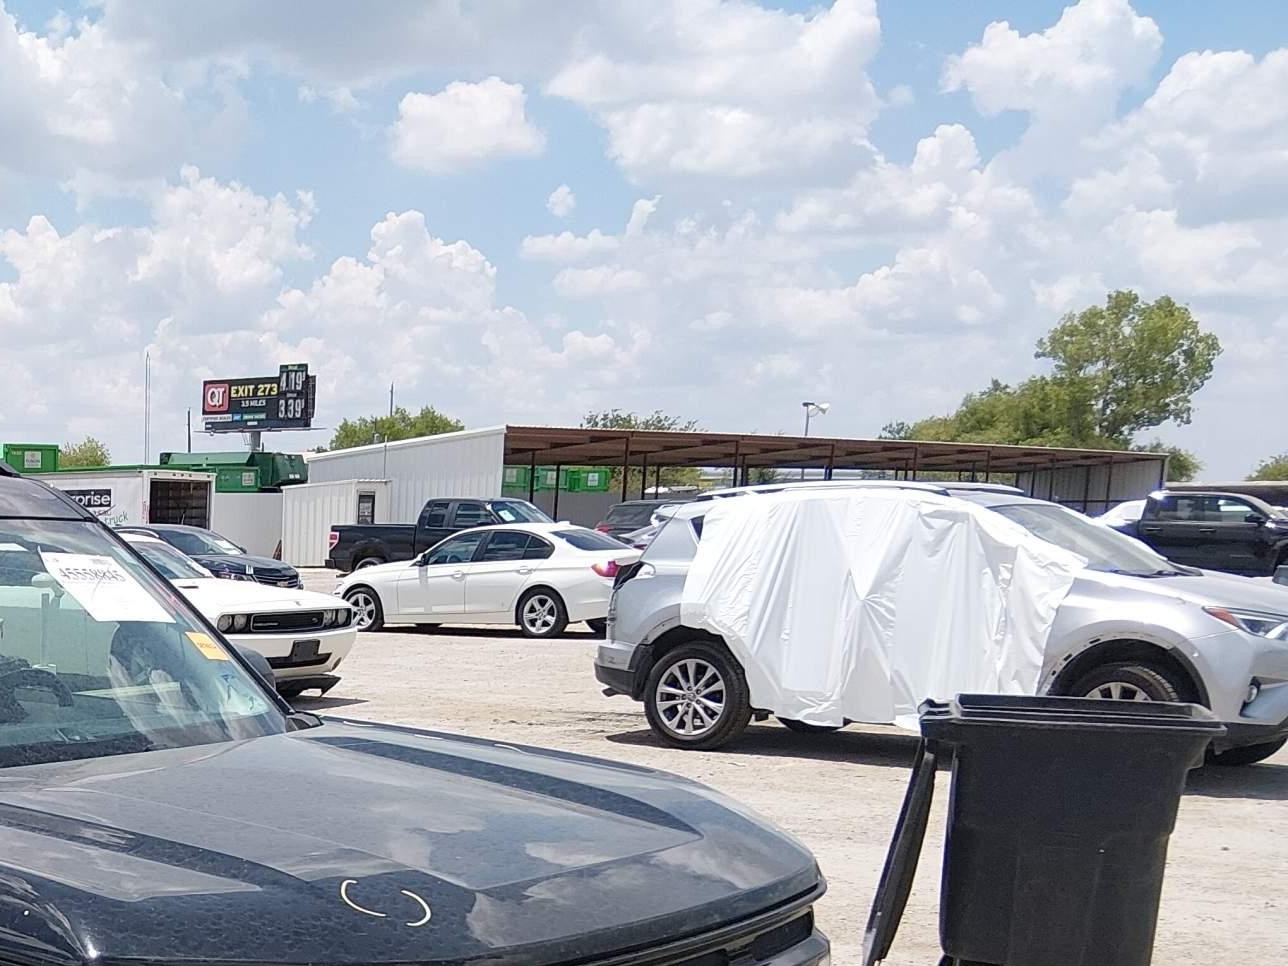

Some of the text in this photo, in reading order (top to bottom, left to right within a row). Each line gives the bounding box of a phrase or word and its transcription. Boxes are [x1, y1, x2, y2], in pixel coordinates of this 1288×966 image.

[207, 387, 225, 407] QT
[230, 383, 278, 398] EXIT 273
